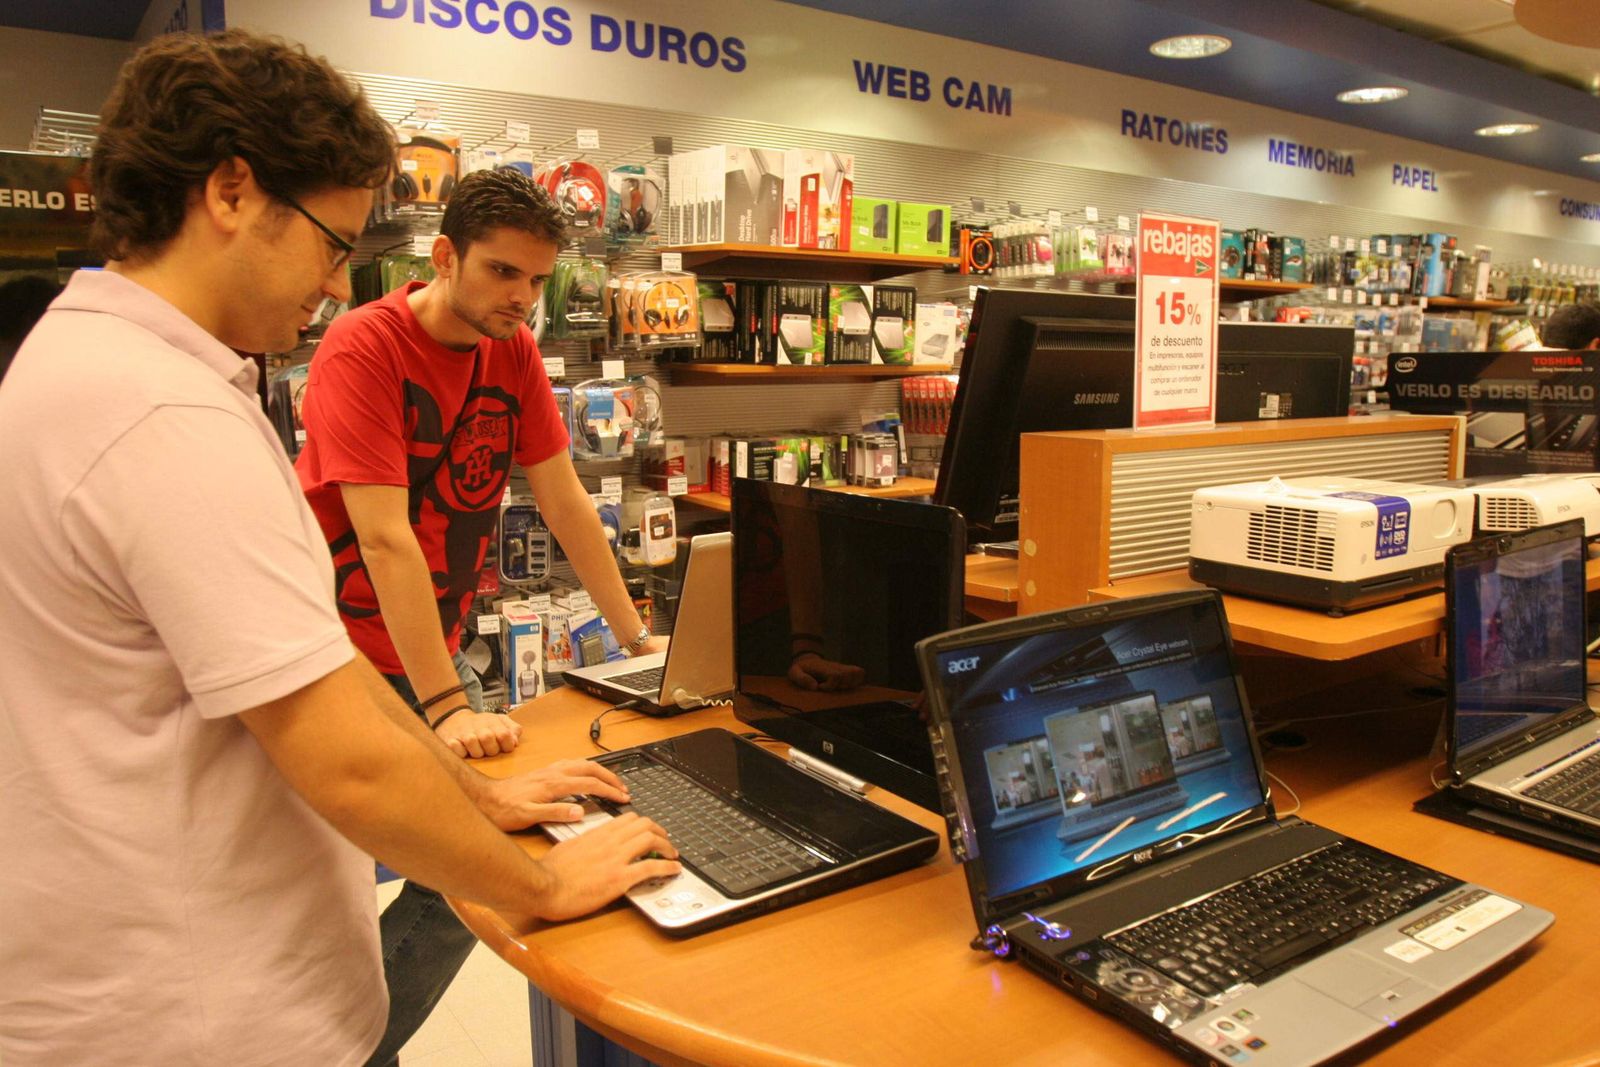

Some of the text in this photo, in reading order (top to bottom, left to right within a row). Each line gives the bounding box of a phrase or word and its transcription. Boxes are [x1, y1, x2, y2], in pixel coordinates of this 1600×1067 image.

[590, 14, 748, 73] DUROS
[853, 60, 1013, 117] WEB CAM
[1121, 109, 1228, 154] RATONES
[1268, 139, 1355, 177] MEMORIA
[1392, 164, 1438, 192] PAPEL
[1142, 223, 1213, 262] rebajas
[1155, 291, 1202, 325] 15%
[1150, 335, 1203, 347] de descuento
[1396, 356, 1583, 370] intel TOSHIBA
[1073, 392, 1120, 406] SAMSUNG
[1395, 383, 1595, 400] VERLO ES DESEARLO
[1132, 644, 1155, 658] Crystal
[1154, 642, 1168, 653] Eye
[948, 655, 980, 674] acer
